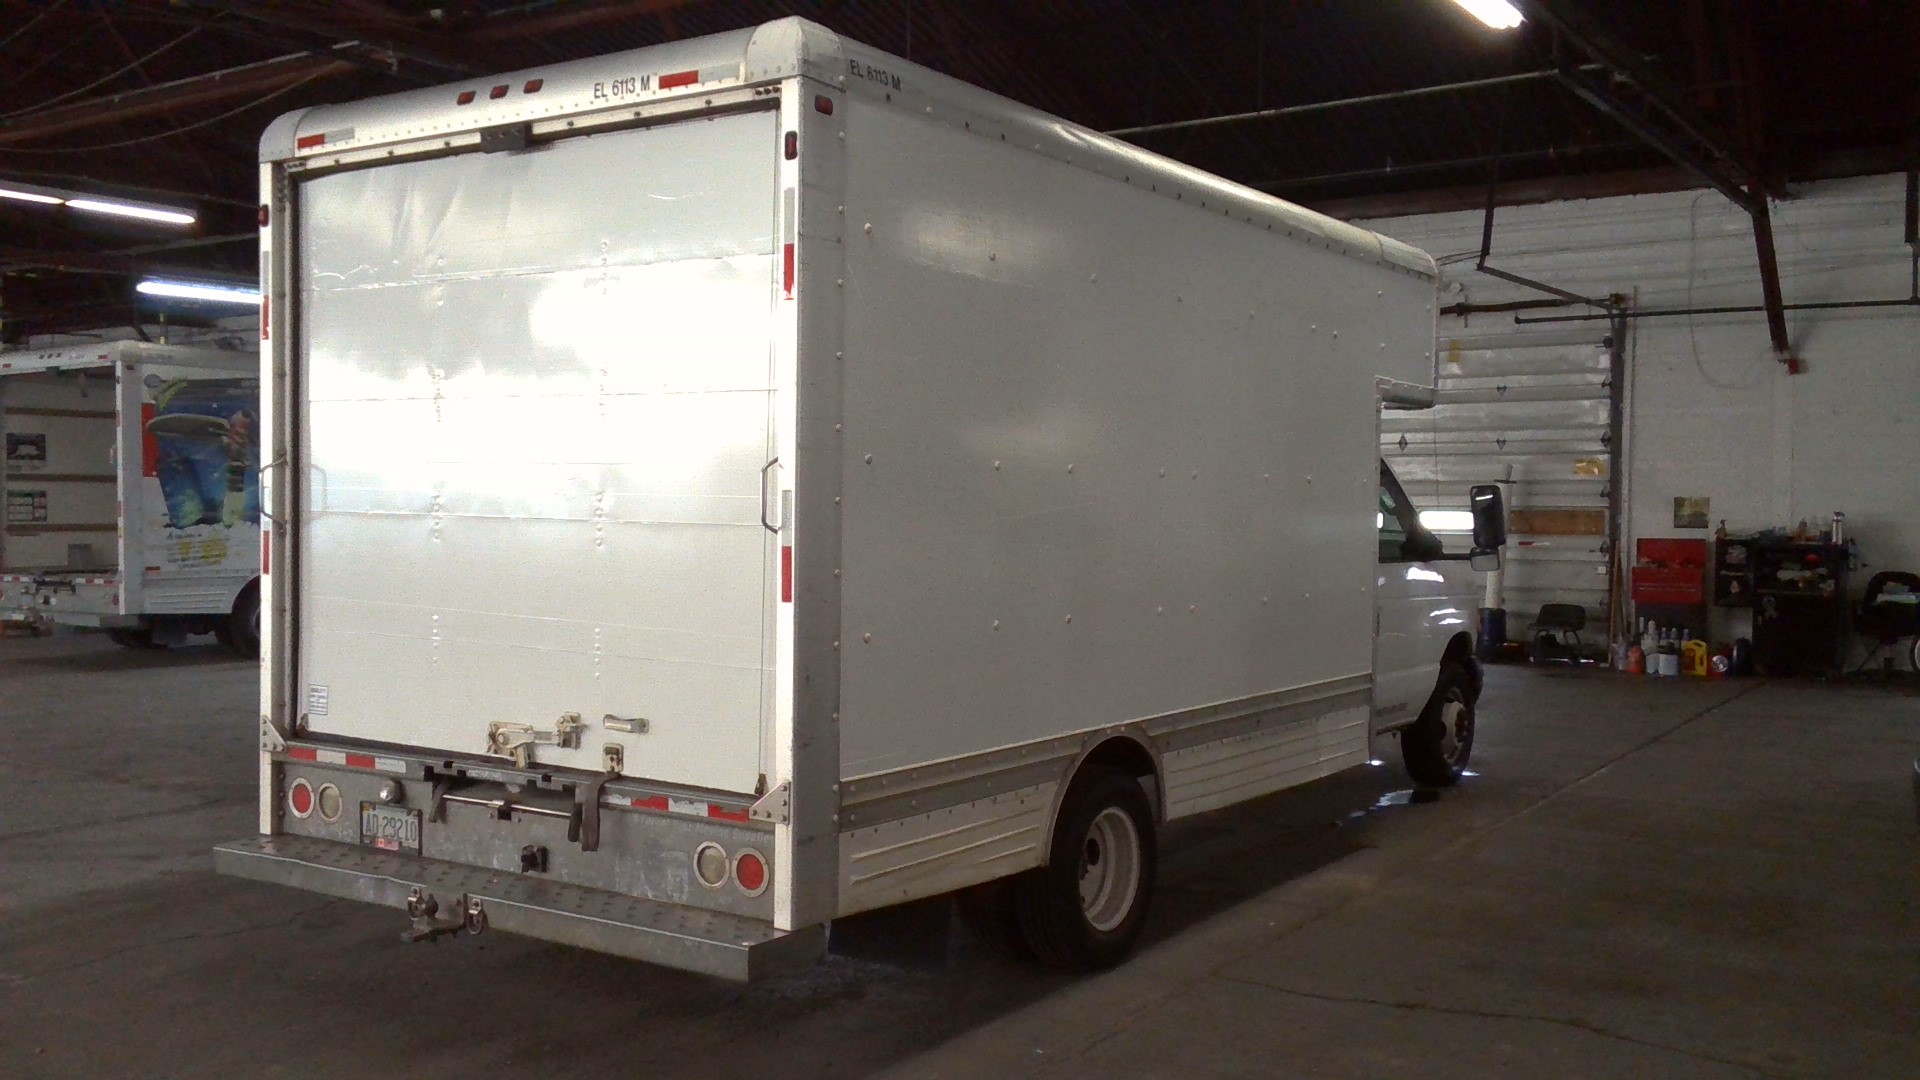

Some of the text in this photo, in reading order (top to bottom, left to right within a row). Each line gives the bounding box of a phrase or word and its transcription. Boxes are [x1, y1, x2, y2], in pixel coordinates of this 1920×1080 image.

[594, 74, 650, 99] EL 6113 M
[849, 59, 902, 92] EL 6113 M
